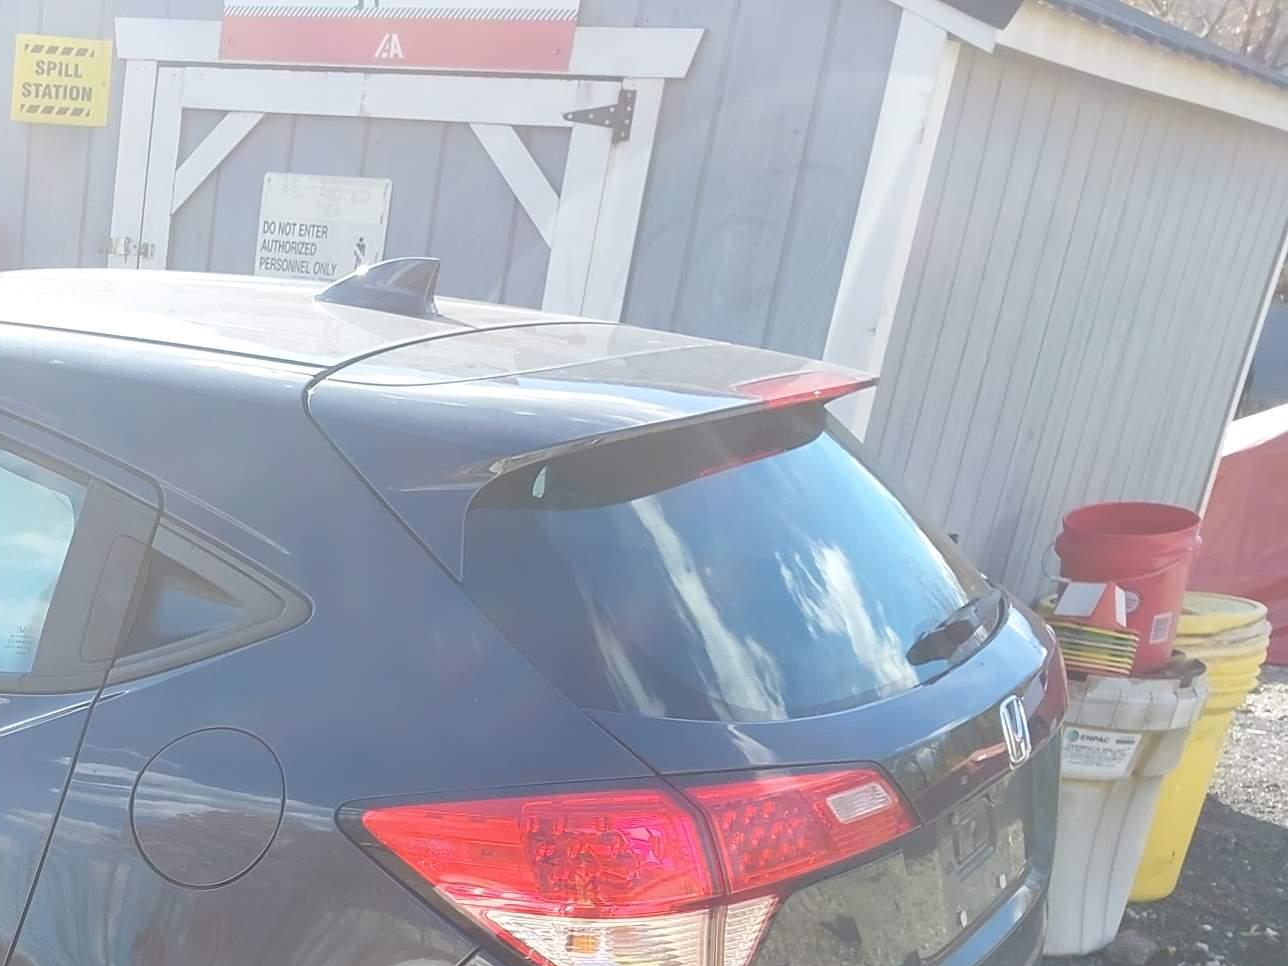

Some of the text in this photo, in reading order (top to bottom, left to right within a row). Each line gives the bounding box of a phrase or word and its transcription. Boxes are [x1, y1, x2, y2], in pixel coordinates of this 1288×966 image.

[35, 60, 82, 78] SPILL
[21, 82, 92, 102] STATION
[263, 221, 328, 239] DO NOT ENTER
[260, 239, 317, 256] AUTHORIZED
[259, 257, 338, 277] PERSONNEL ONLY
